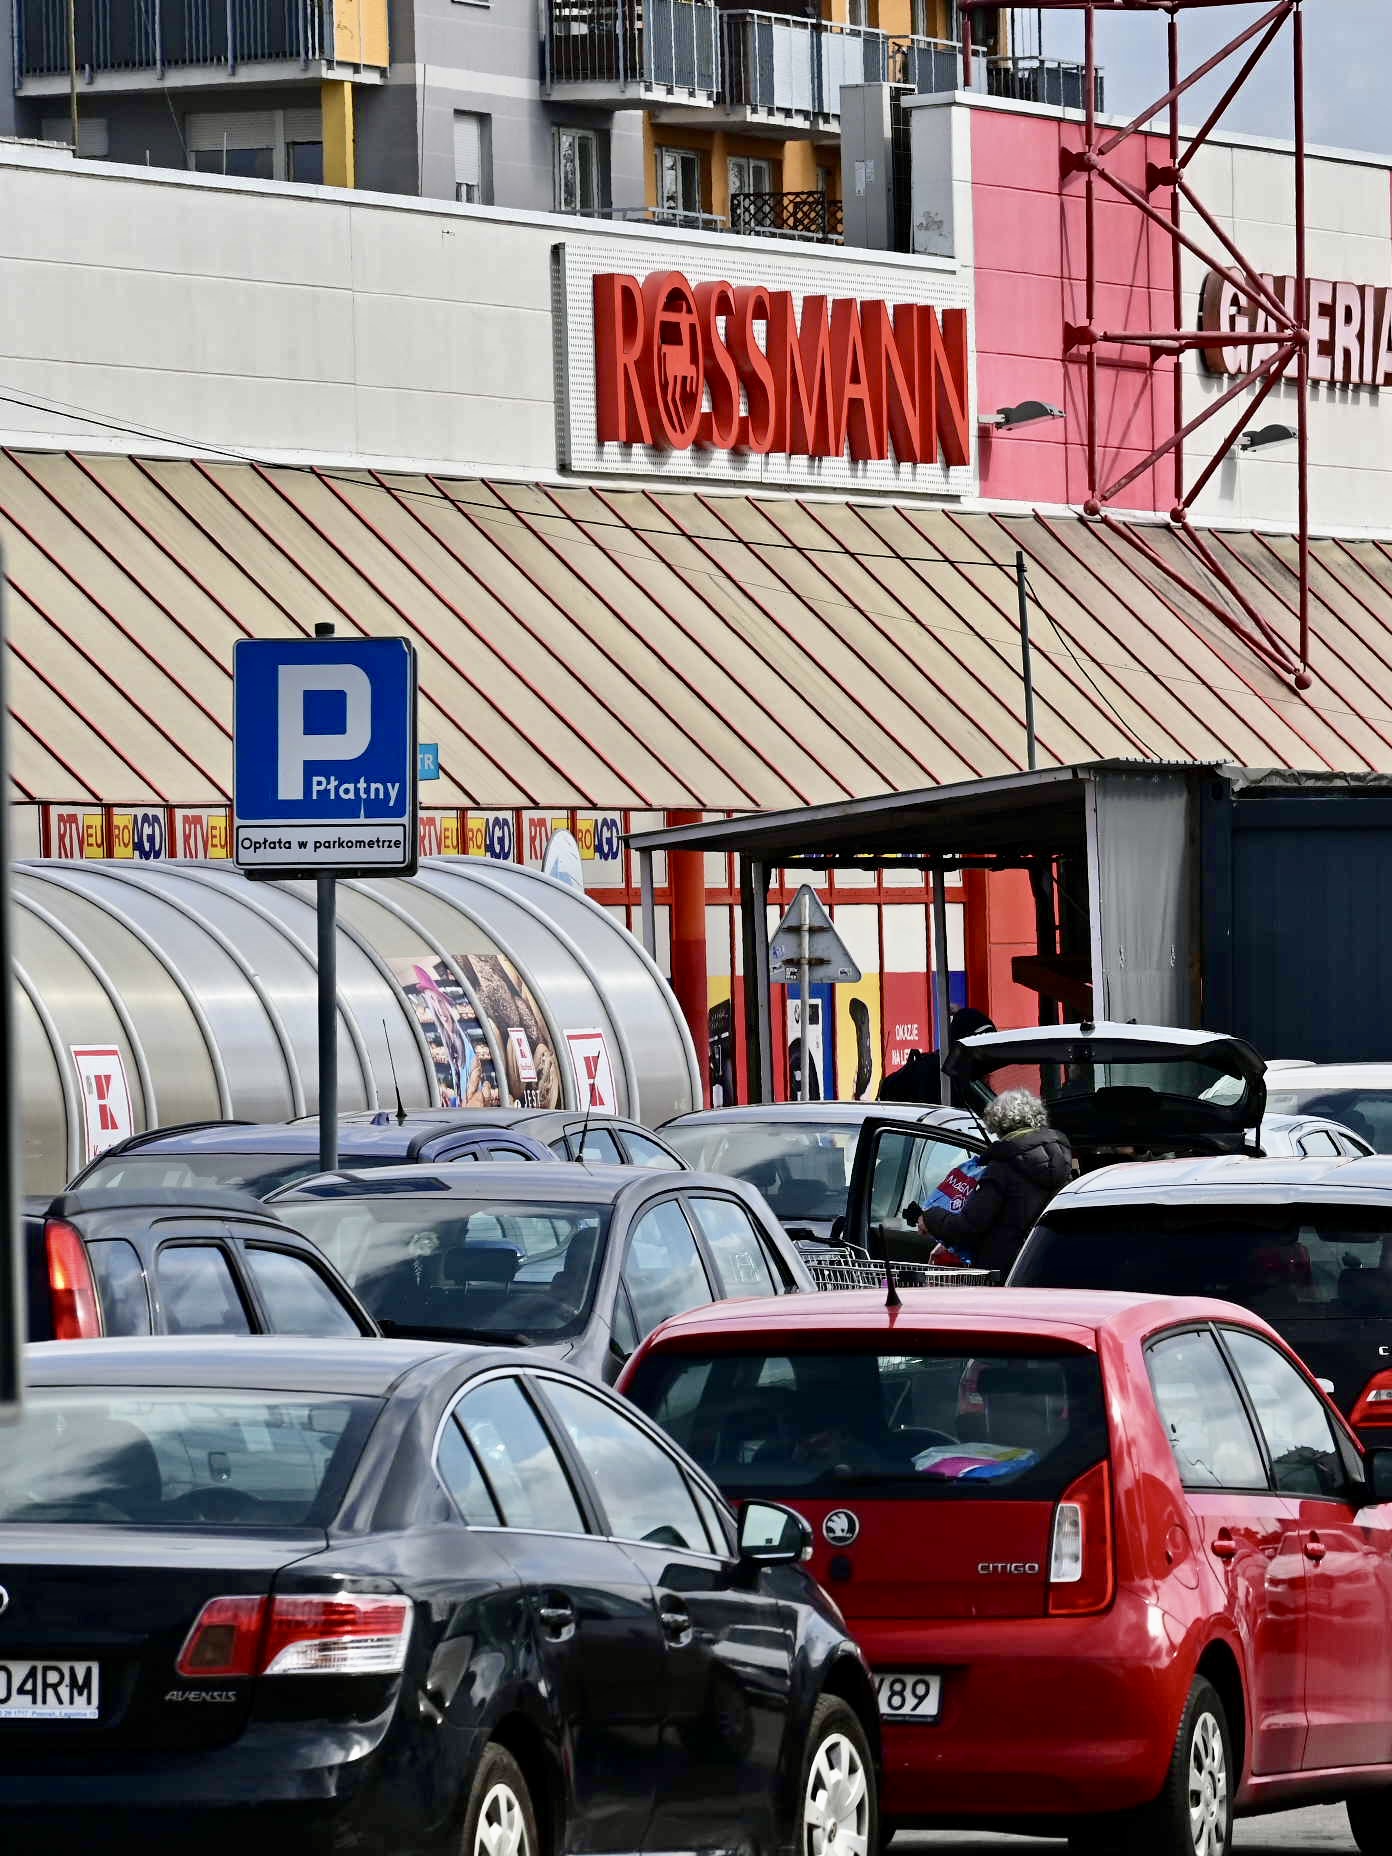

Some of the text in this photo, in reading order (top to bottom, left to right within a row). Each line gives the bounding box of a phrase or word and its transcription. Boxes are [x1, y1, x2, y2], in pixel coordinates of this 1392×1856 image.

[593, 271, 970, 466] ROSSMANN
[278, 663, 371, 800] P
[311, 775, 400, 807] Płatny
[57, 813, 84, 859] RTV
[132, 813, 163, 860] AGD
[182, 815, 208, 859] RTV
[241, 836, 402, 853] Opłata w parkometrze
[485, 816, 512, 860] AGD
[594, 817, 619, 861] AGD
[977, 1562, 1039, 1574] CITIGO
[165, 1690, 236, 1702] AVENSIS
